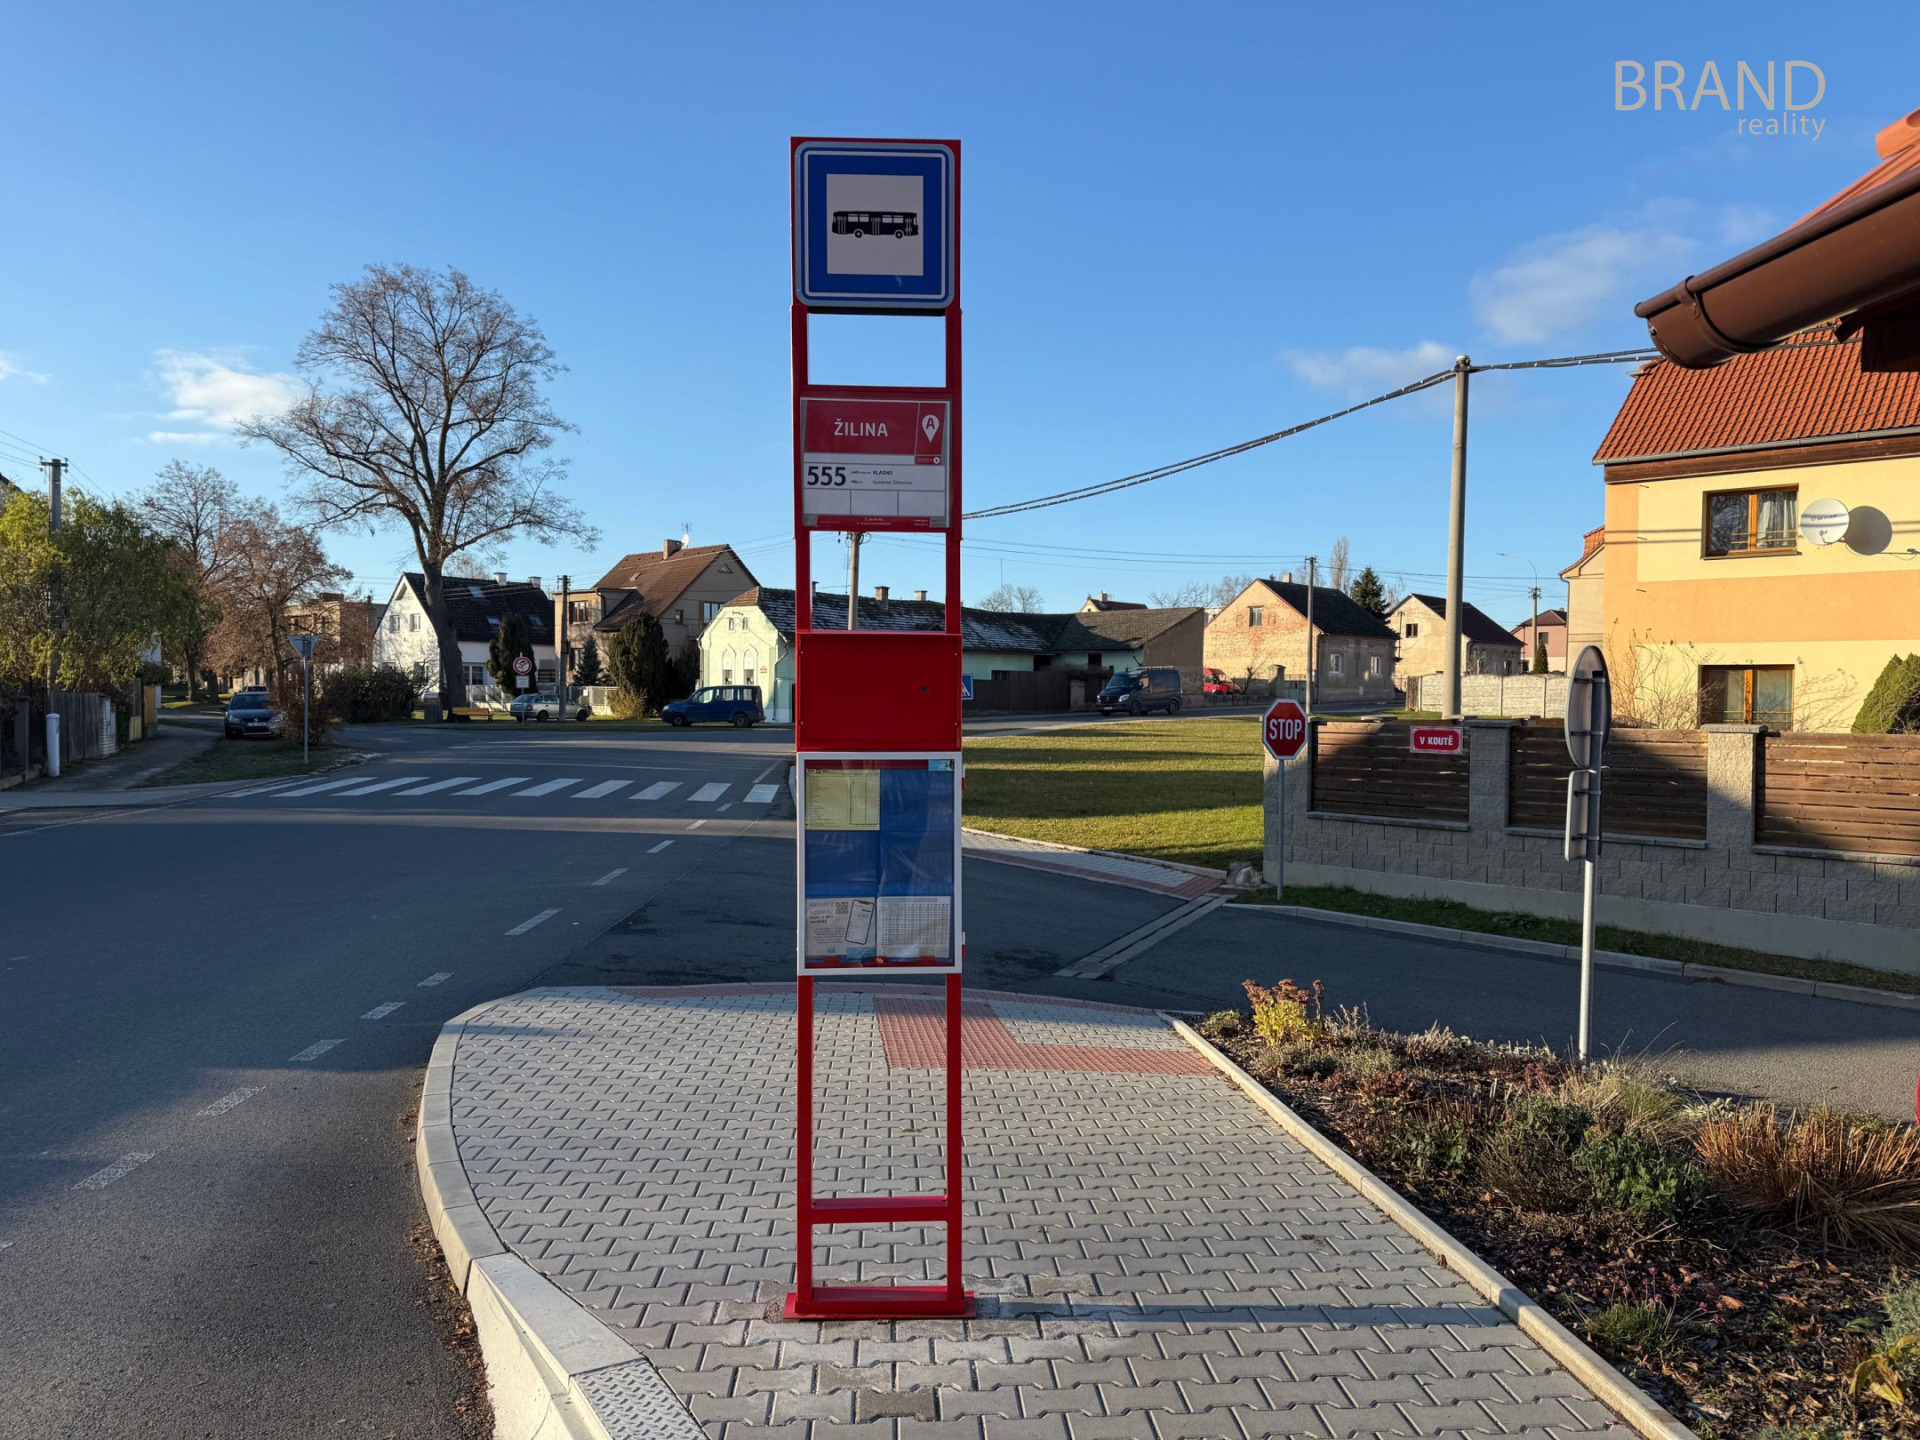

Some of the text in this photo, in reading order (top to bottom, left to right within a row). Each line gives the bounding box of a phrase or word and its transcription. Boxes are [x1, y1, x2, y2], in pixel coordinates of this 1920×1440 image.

[834, 418, 888, 437] ŽILINA
[926, 417, 935, 430] A
[807, 466, 846, 487] 555
[1269, 718, 1302, 740] STOP
[1419, 735, 1454, 746] V KOUTĚ
